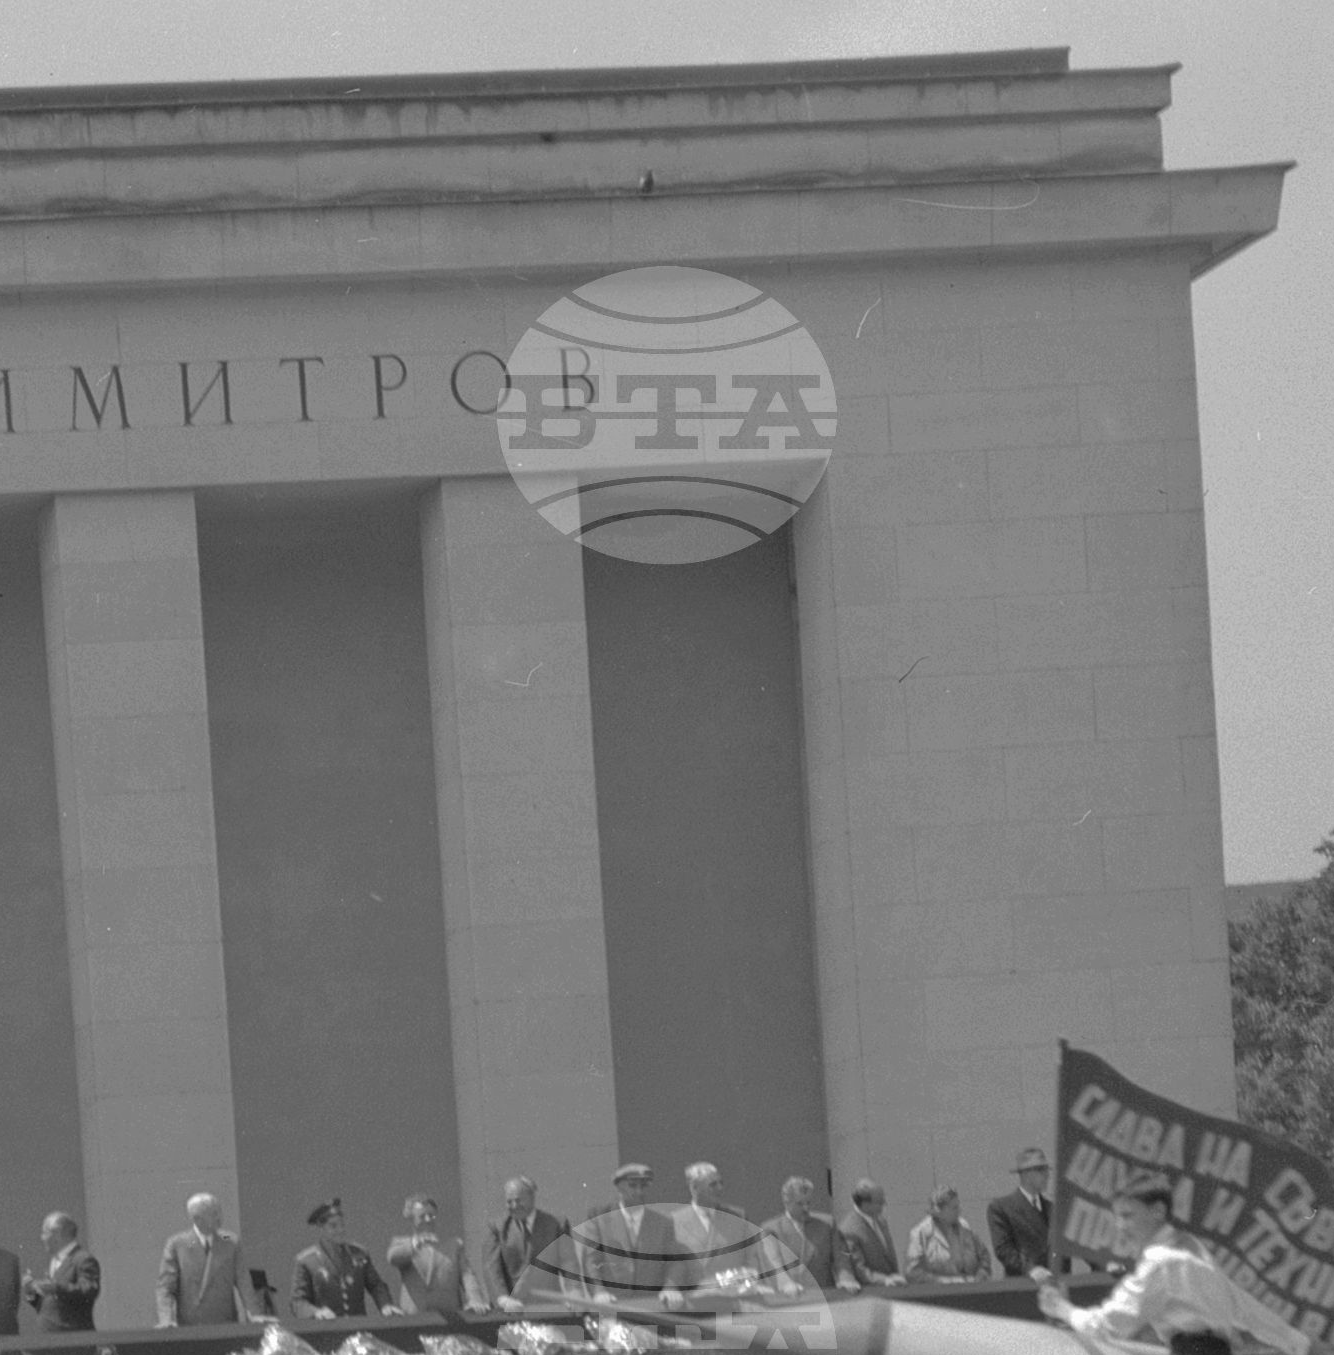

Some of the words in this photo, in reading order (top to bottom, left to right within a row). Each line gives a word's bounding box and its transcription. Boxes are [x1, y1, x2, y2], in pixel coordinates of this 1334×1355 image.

[1069, 1084, 1184, 1169] СЛАВА
[1195, 1130, 1253, 1189] НА
[1203, 1187, 1245, 1235] И
